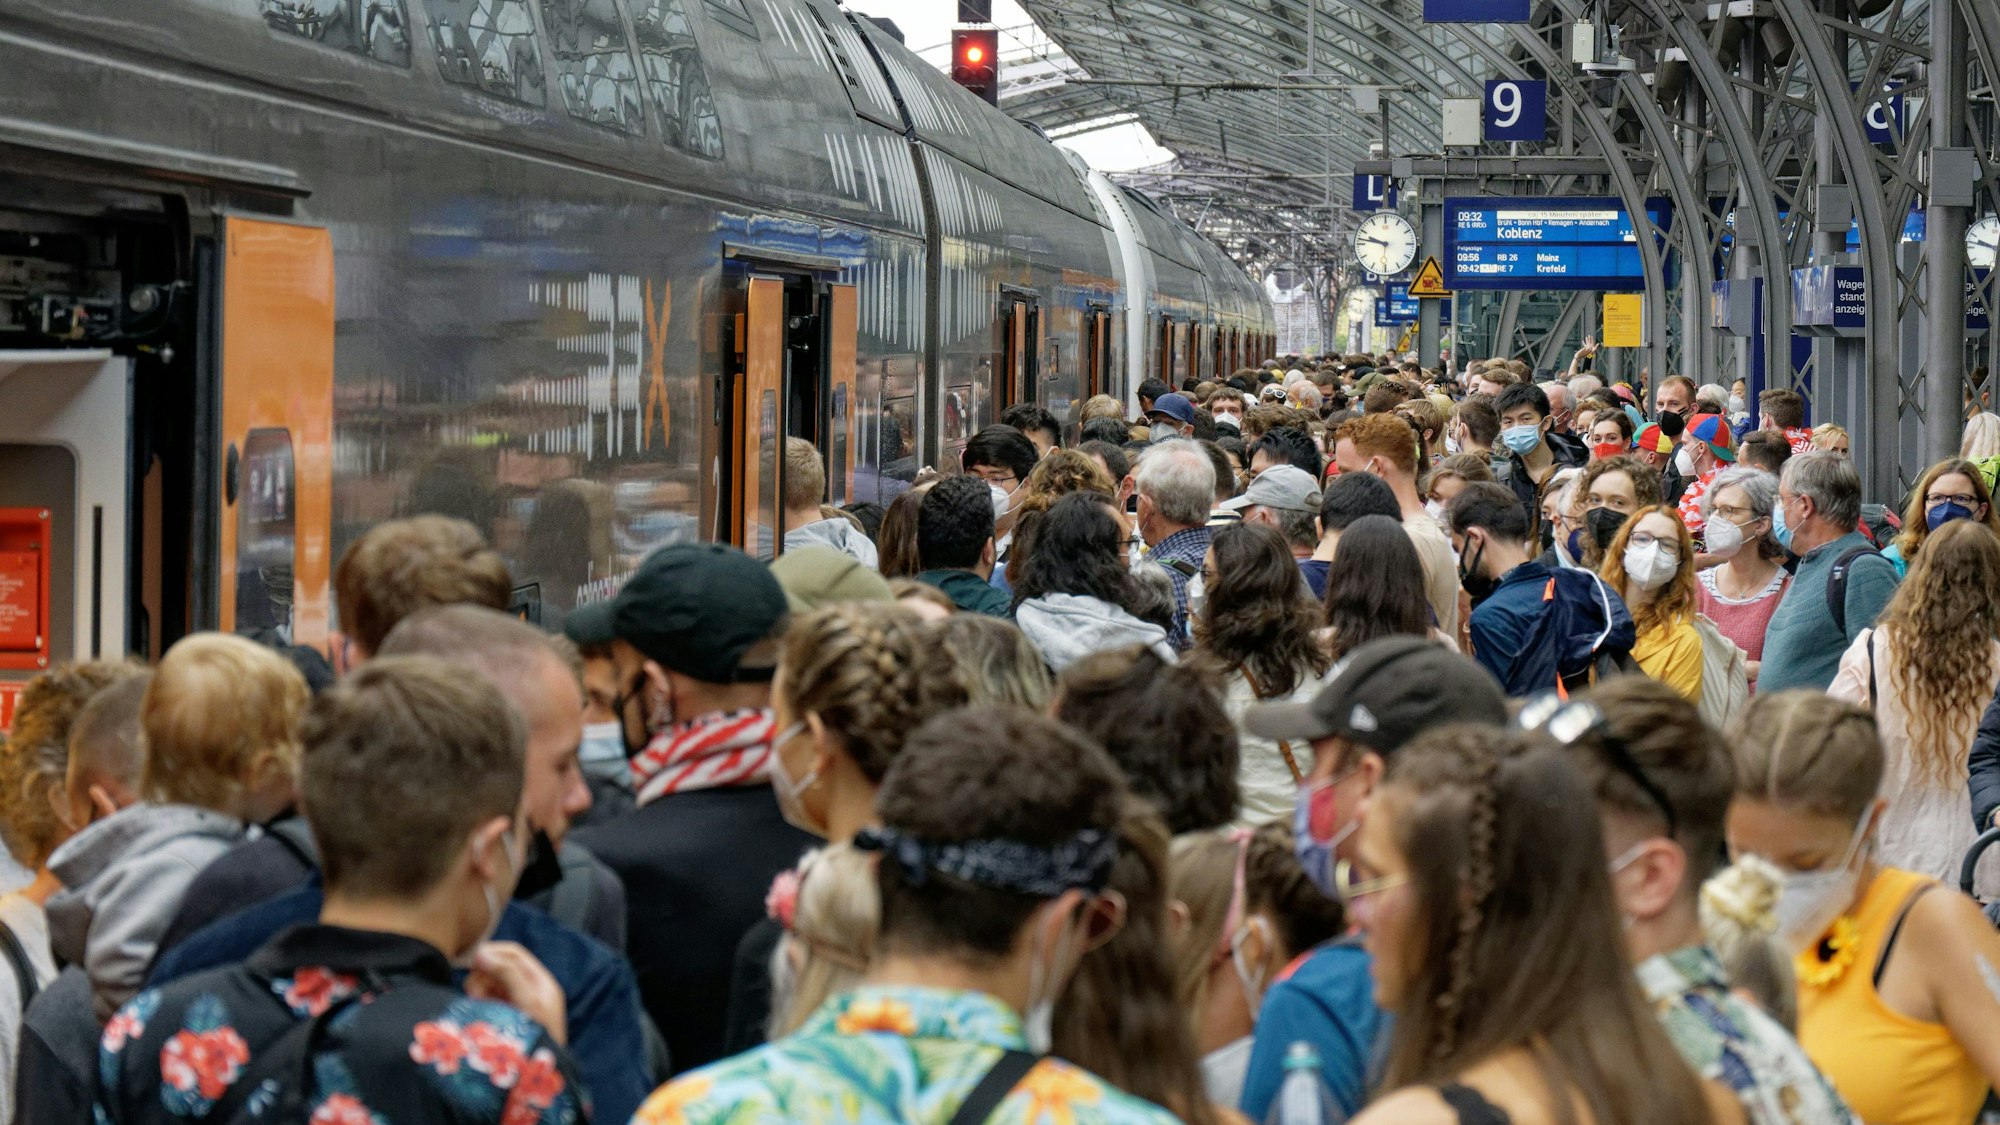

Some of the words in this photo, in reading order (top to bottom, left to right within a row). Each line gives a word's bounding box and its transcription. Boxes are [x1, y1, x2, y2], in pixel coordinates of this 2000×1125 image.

[1493, 82, 1522, 128] 9
[1458, 212, 1482, 221] 09:32
[1497, 227, 1542, 239] Koblenz
[1457, 253, 1479, 261] 09:56
[1537, 254, 1559, 262] Mainz
[1457, 265, 1479, 273] 09:42
[1537, 265, 1566, 273] Krefeld
[1840, 293, 1865, 301] stand
[1835, 304, 1864, 315] anzeig
